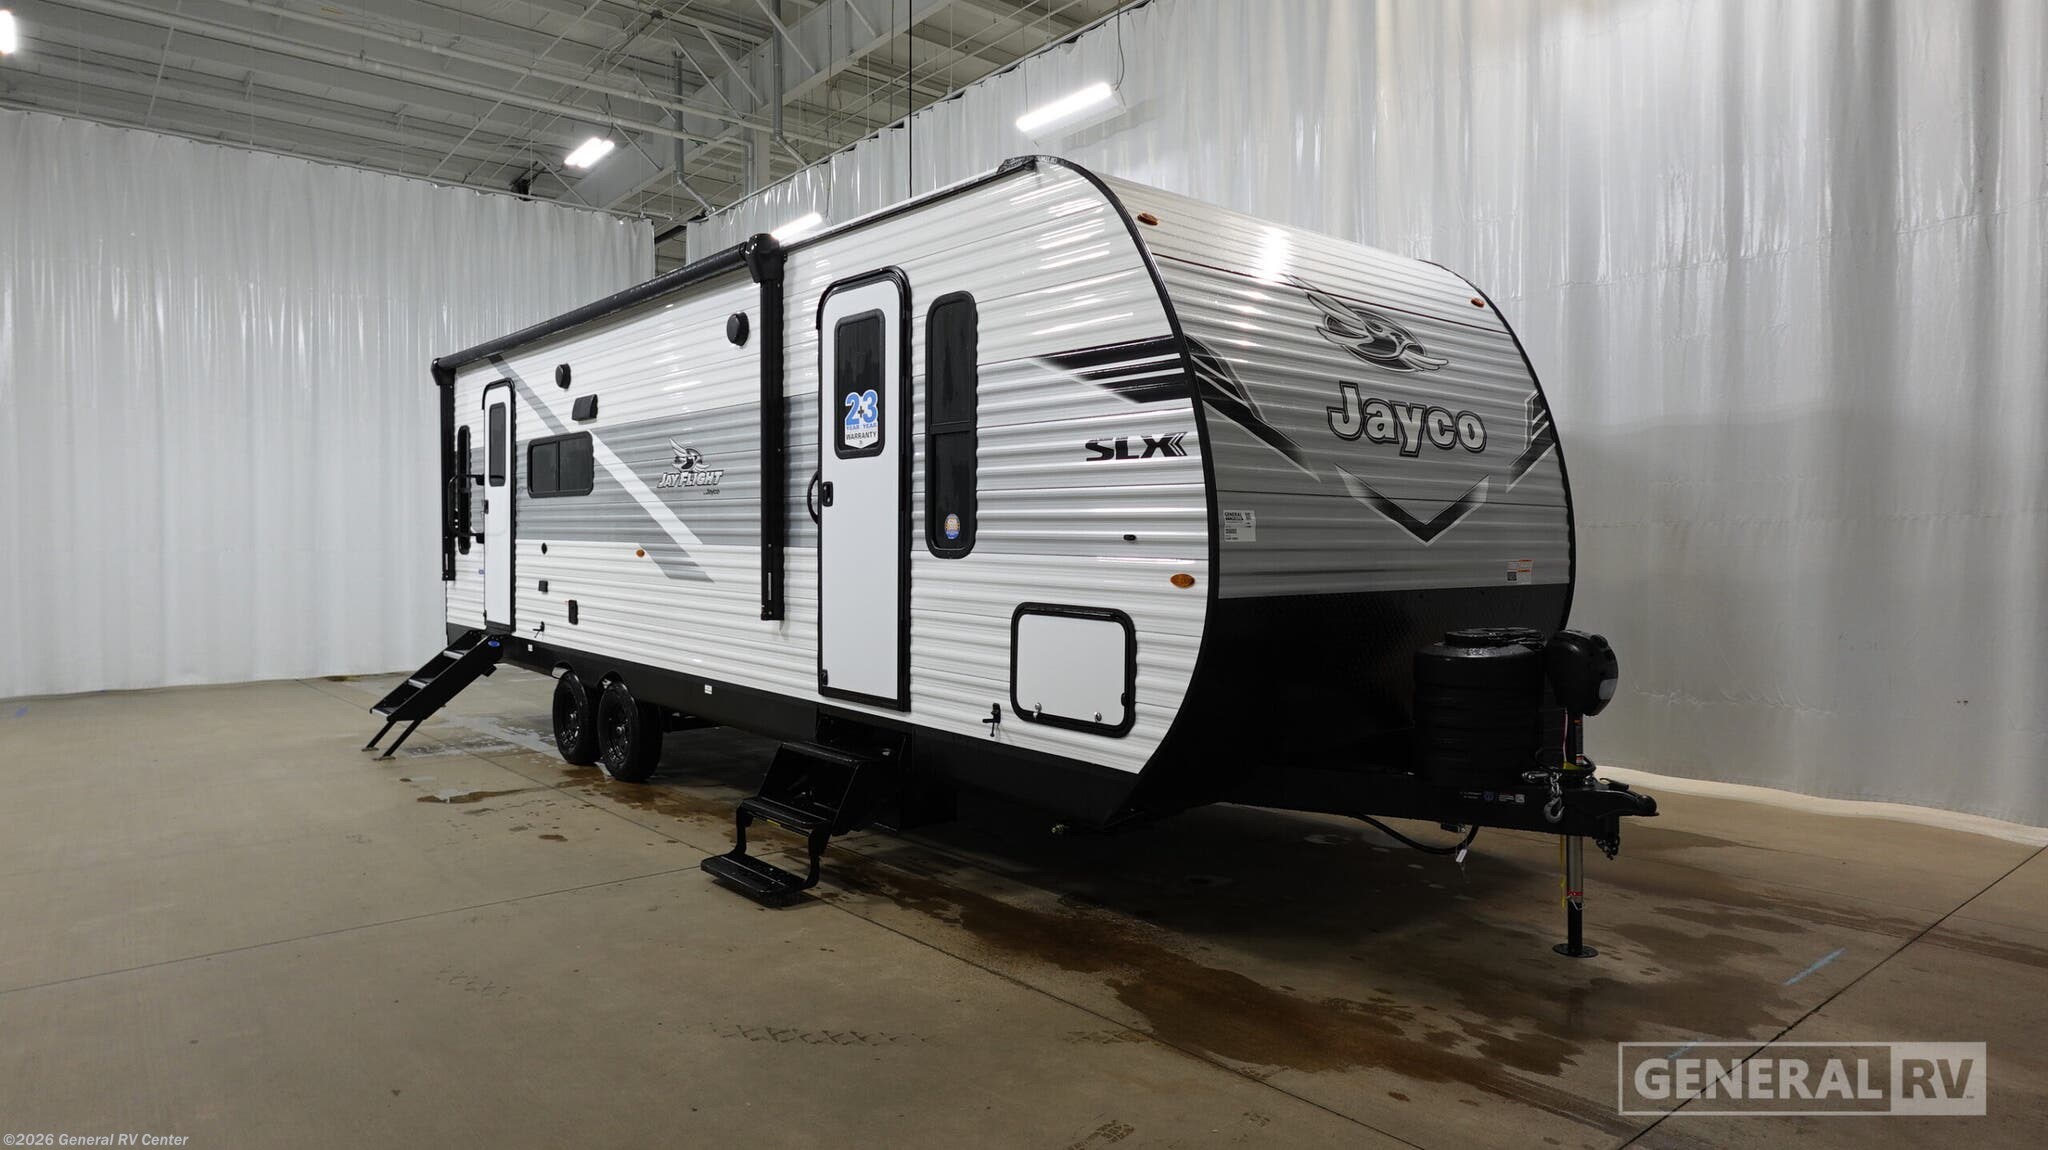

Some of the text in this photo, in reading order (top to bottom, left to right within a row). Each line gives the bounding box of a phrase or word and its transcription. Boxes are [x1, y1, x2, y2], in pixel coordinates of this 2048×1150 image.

[1326, 380, 1487, 458] Jayco
[846, 431, 877, 440] WARRANTY
[1085, 432, 1188, 461] SLX
[656, 470, 724, 488] JAY FLIGHT
